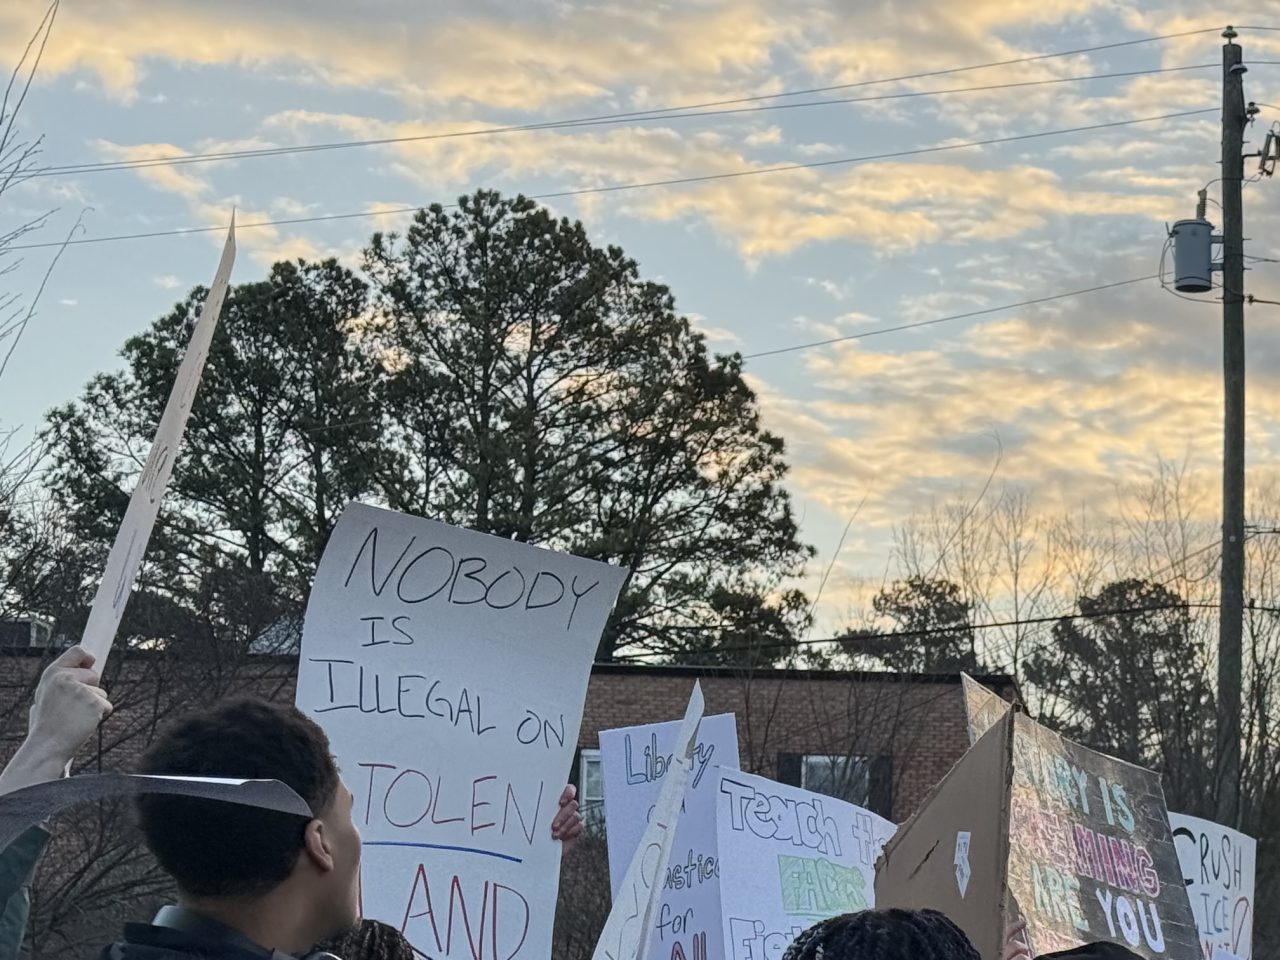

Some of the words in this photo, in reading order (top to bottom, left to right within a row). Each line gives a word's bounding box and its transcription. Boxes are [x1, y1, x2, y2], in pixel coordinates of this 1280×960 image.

[345, 528, 600, 631] NOBODY
[360, 615, 415, 646] IS
[308, 657, 497, 736] ILLEGAL
[516, 710, 565, 749] ON
[357, 762, 544, 846] TOLEN
[720, 777, 843, 856] Teach
[1098, 776, 1135, 833] IS
[656, 903, 694, 942] for
[1095, 887, 1166, 954] YOU
[1200, 892, 1230, 935] ICE
